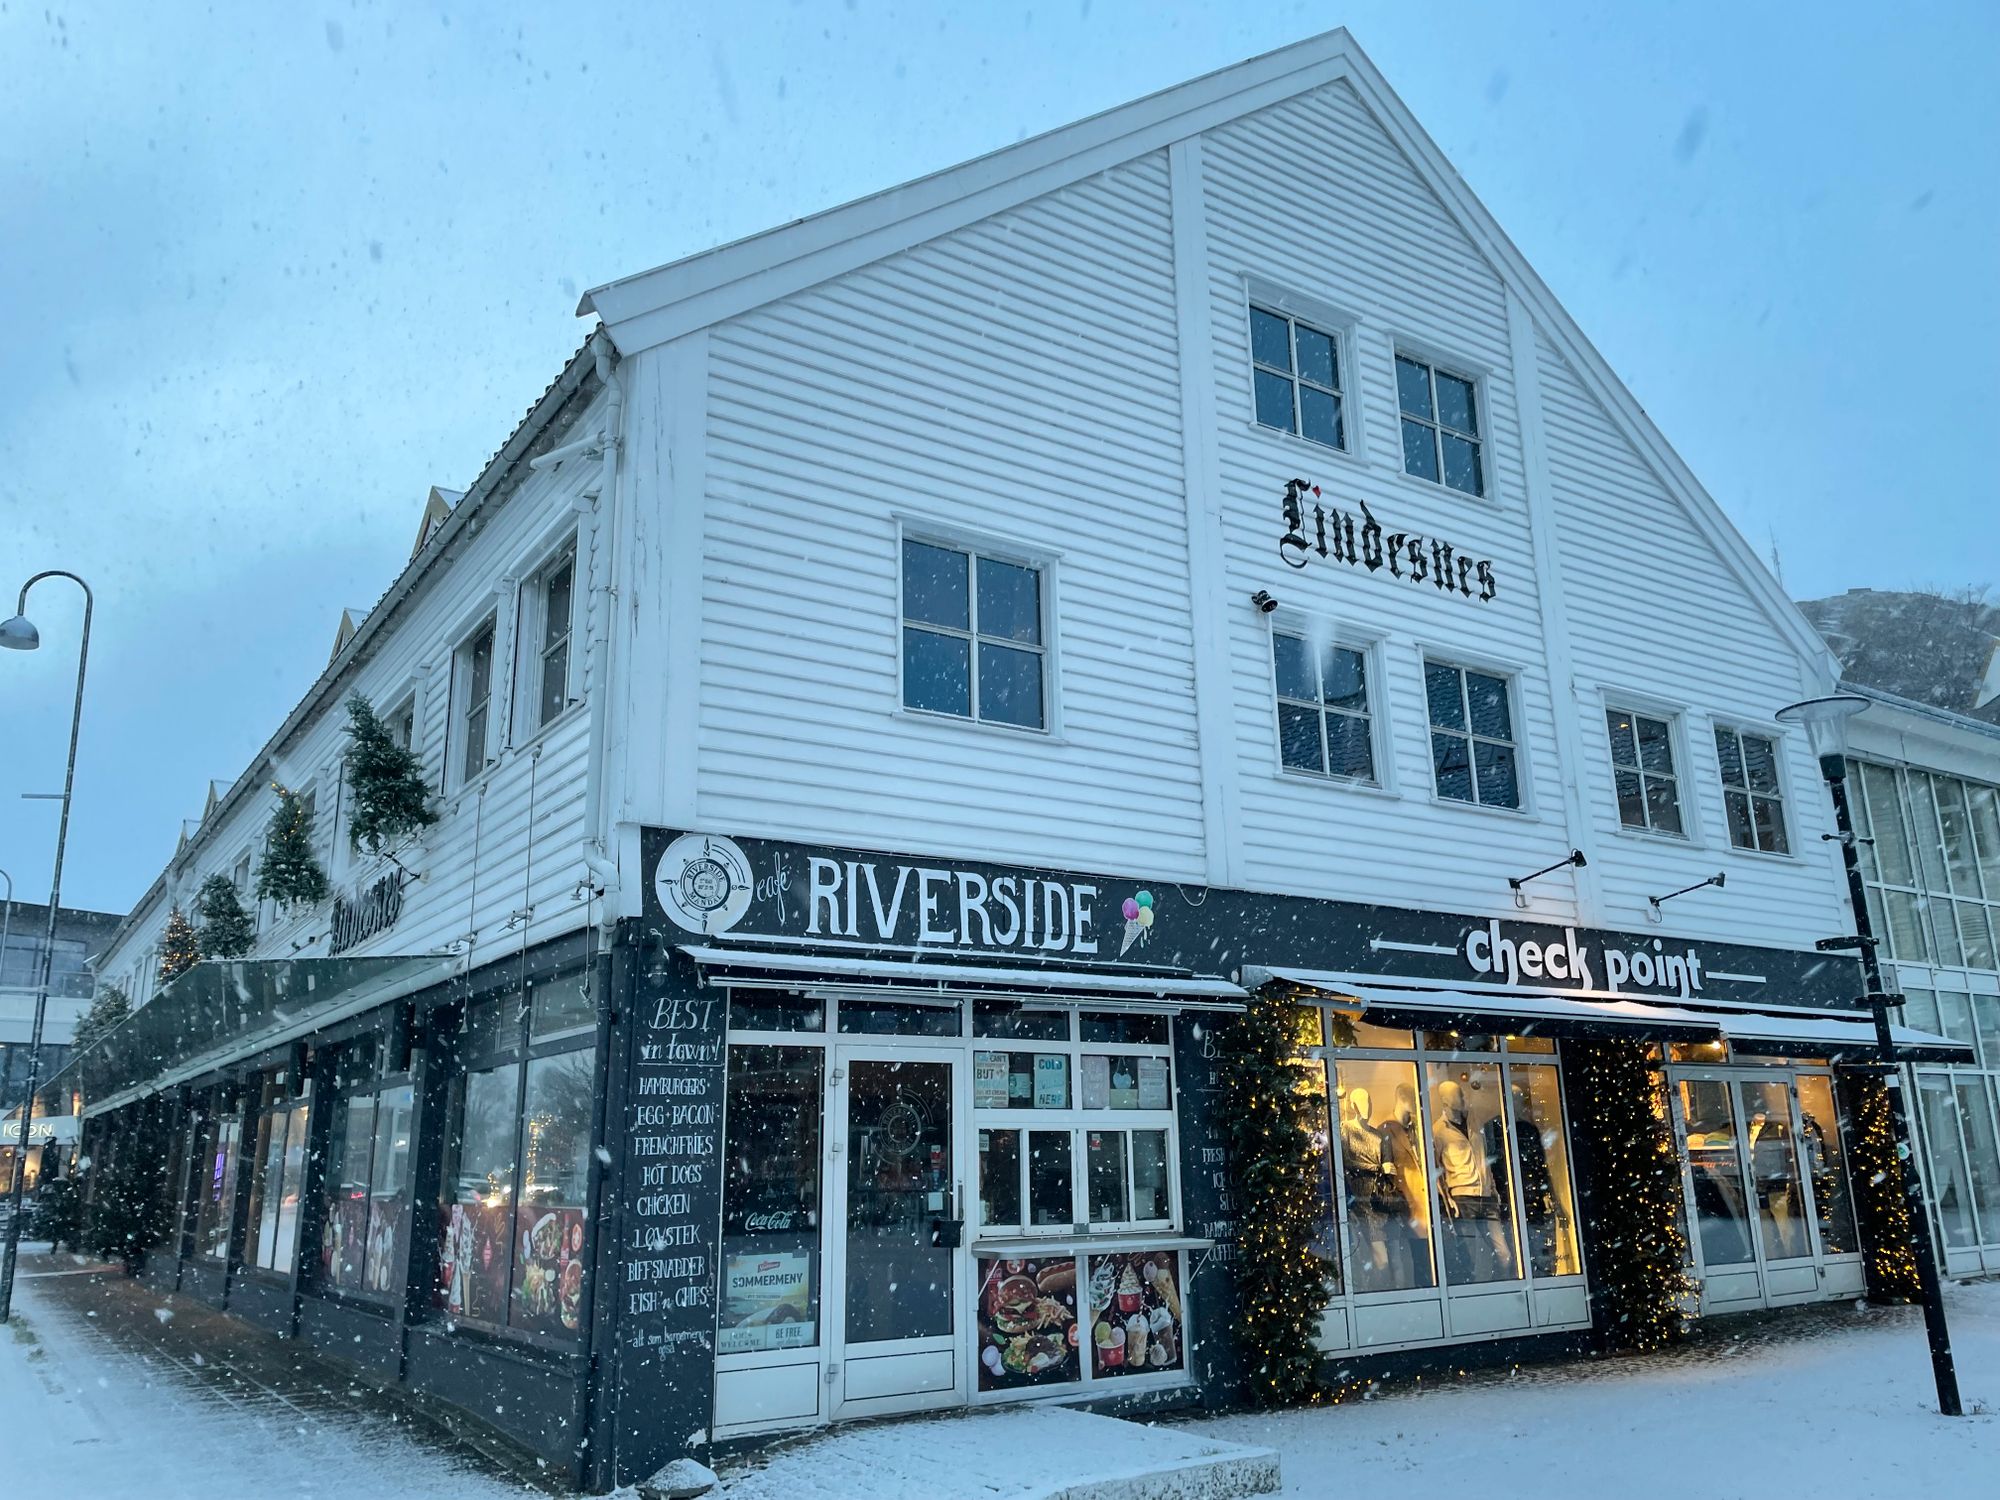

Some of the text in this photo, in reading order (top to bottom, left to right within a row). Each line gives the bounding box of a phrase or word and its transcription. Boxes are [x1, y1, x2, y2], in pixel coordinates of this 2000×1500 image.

[1280, 478, 1496, 603] Lindesnes
[686, 862, 726, 882] RIVERSIDE
[806, 856, 1098, 953] RIVERSIDE
[1465, 919, 1703, 999] check point
[649, 997, 719, 1032] BEST
[643, 1033, 720, 1061] in town!
[976, 1069, 995, 1079] BUT
[639, 1077, 706, 1095] HAMBURGERS
[642, 1164, 702, 1186] HOT DOGS
[637, 1193, 691, 1216] CHICKEN
[627, 1256, 705, 1281] BIFFSNADDER
[732, 1273, 804, 1288] SOMMERMENY
[675, 1286, 707, 1307] CHIPS
